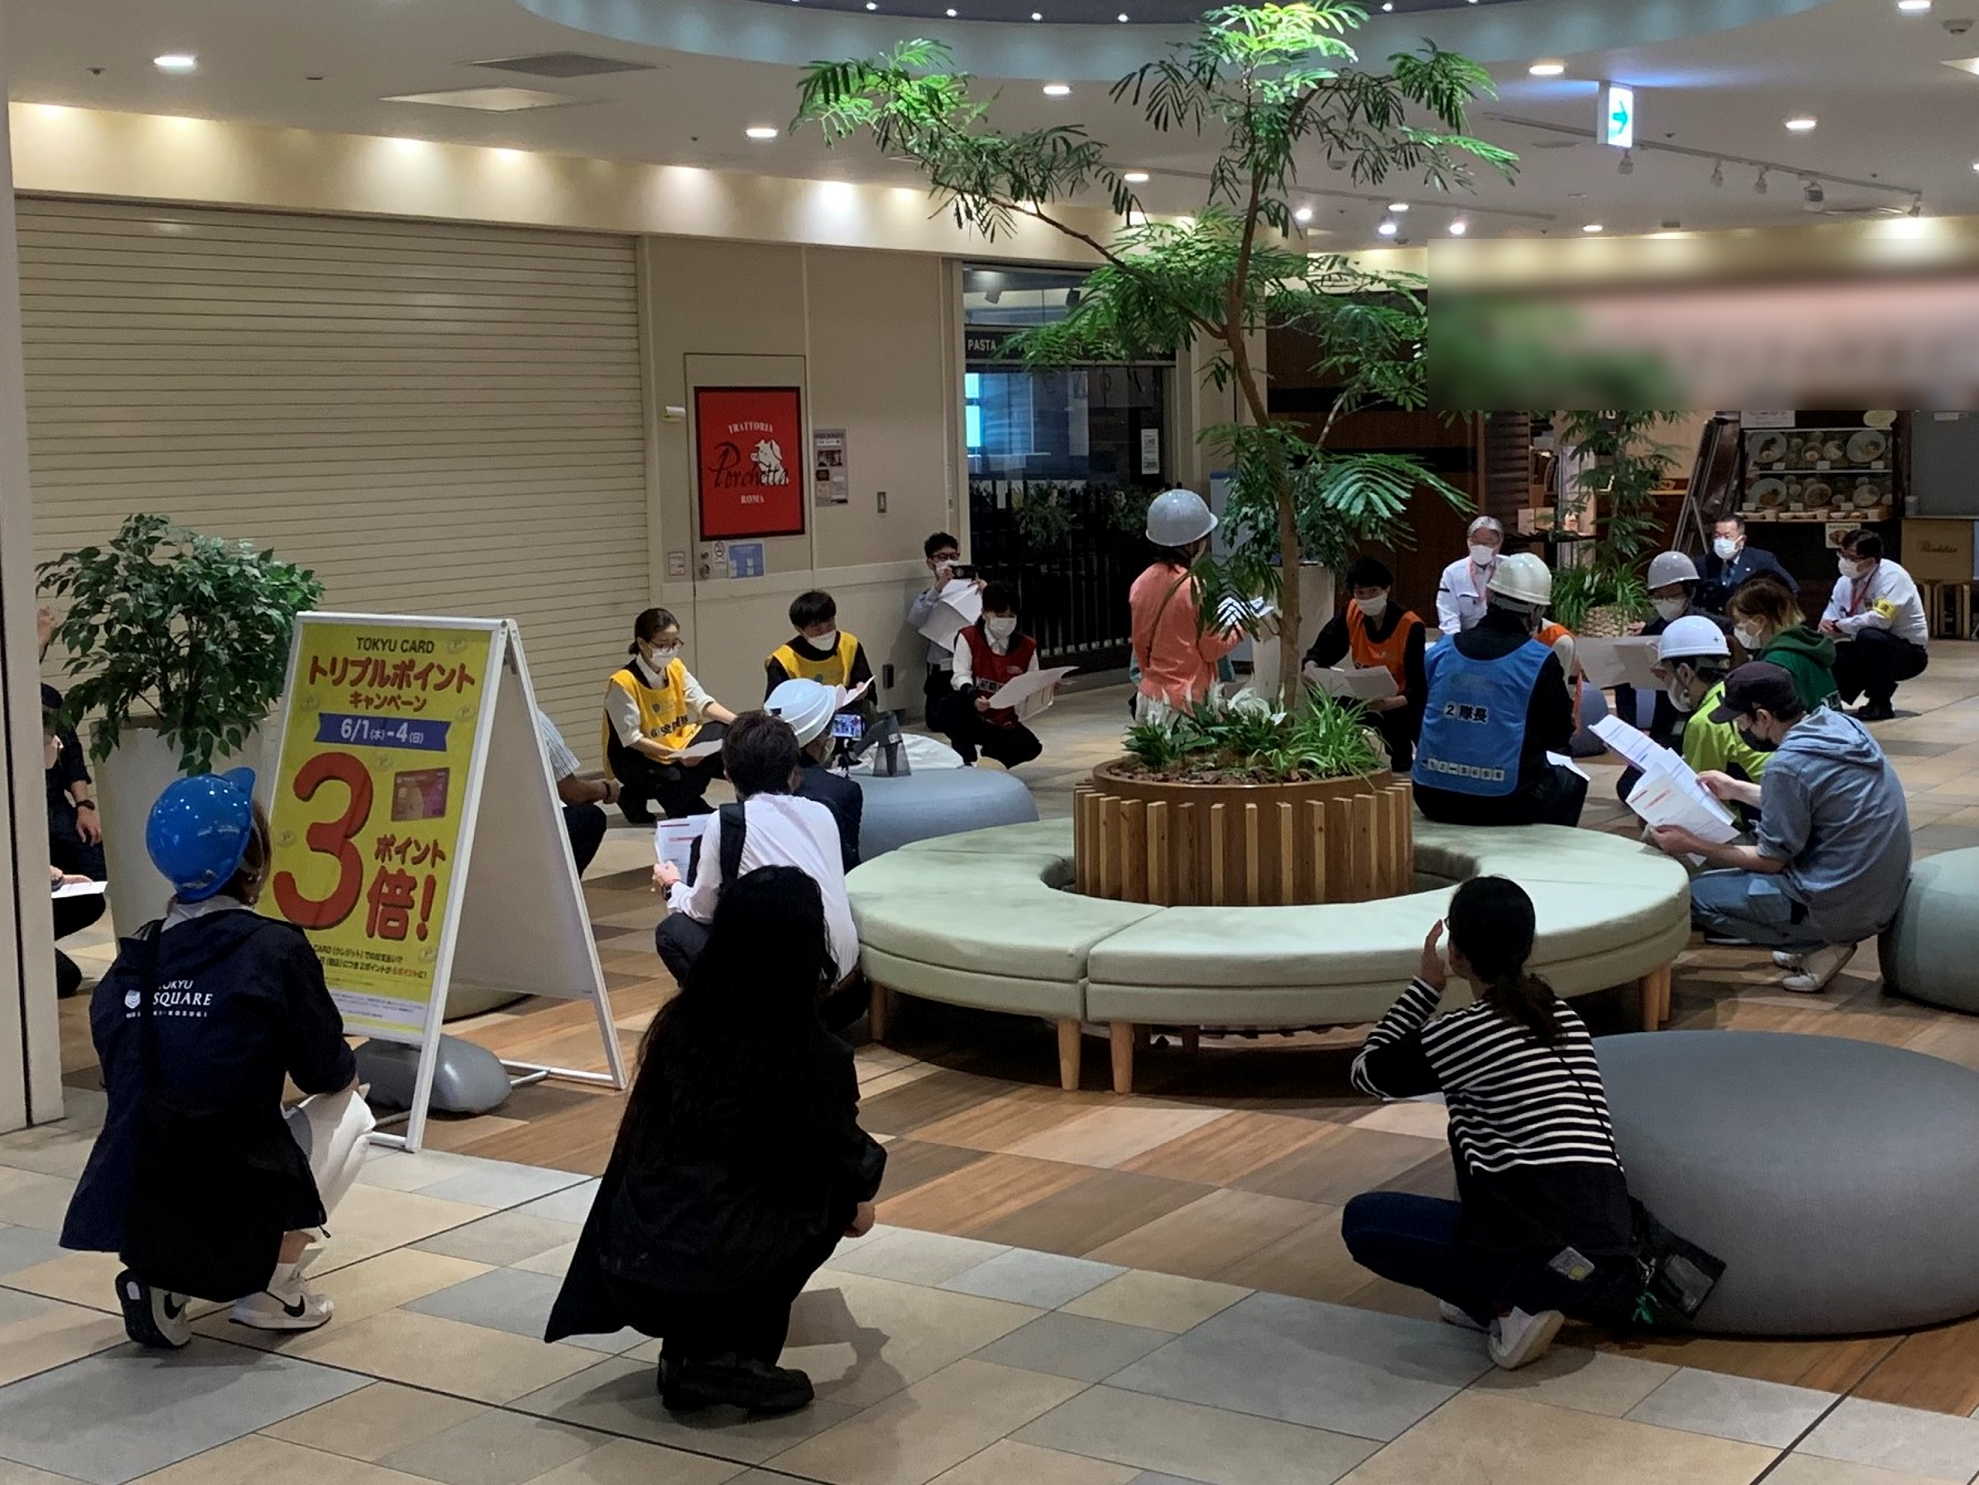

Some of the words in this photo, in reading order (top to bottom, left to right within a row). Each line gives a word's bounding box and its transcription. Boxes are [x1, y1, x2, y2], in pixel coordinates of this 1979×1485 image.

[967, 339, 997, 352] PASTA
[728, 421, 773, 434] TRATTORIA
[740, 494, 764, 504] ROMA
[356, 636, 397, 652] TOKYU
[400, 639, 435, 654] CARD
[308, 655, 475, 694] トリプルポイント
[349, 690, 427, 712] キャンペーン
[374, 834, 446, 868] ポイント
[158, 980, 194, 990] OKYU
[152, 992, 213, 1007] SQUARE
